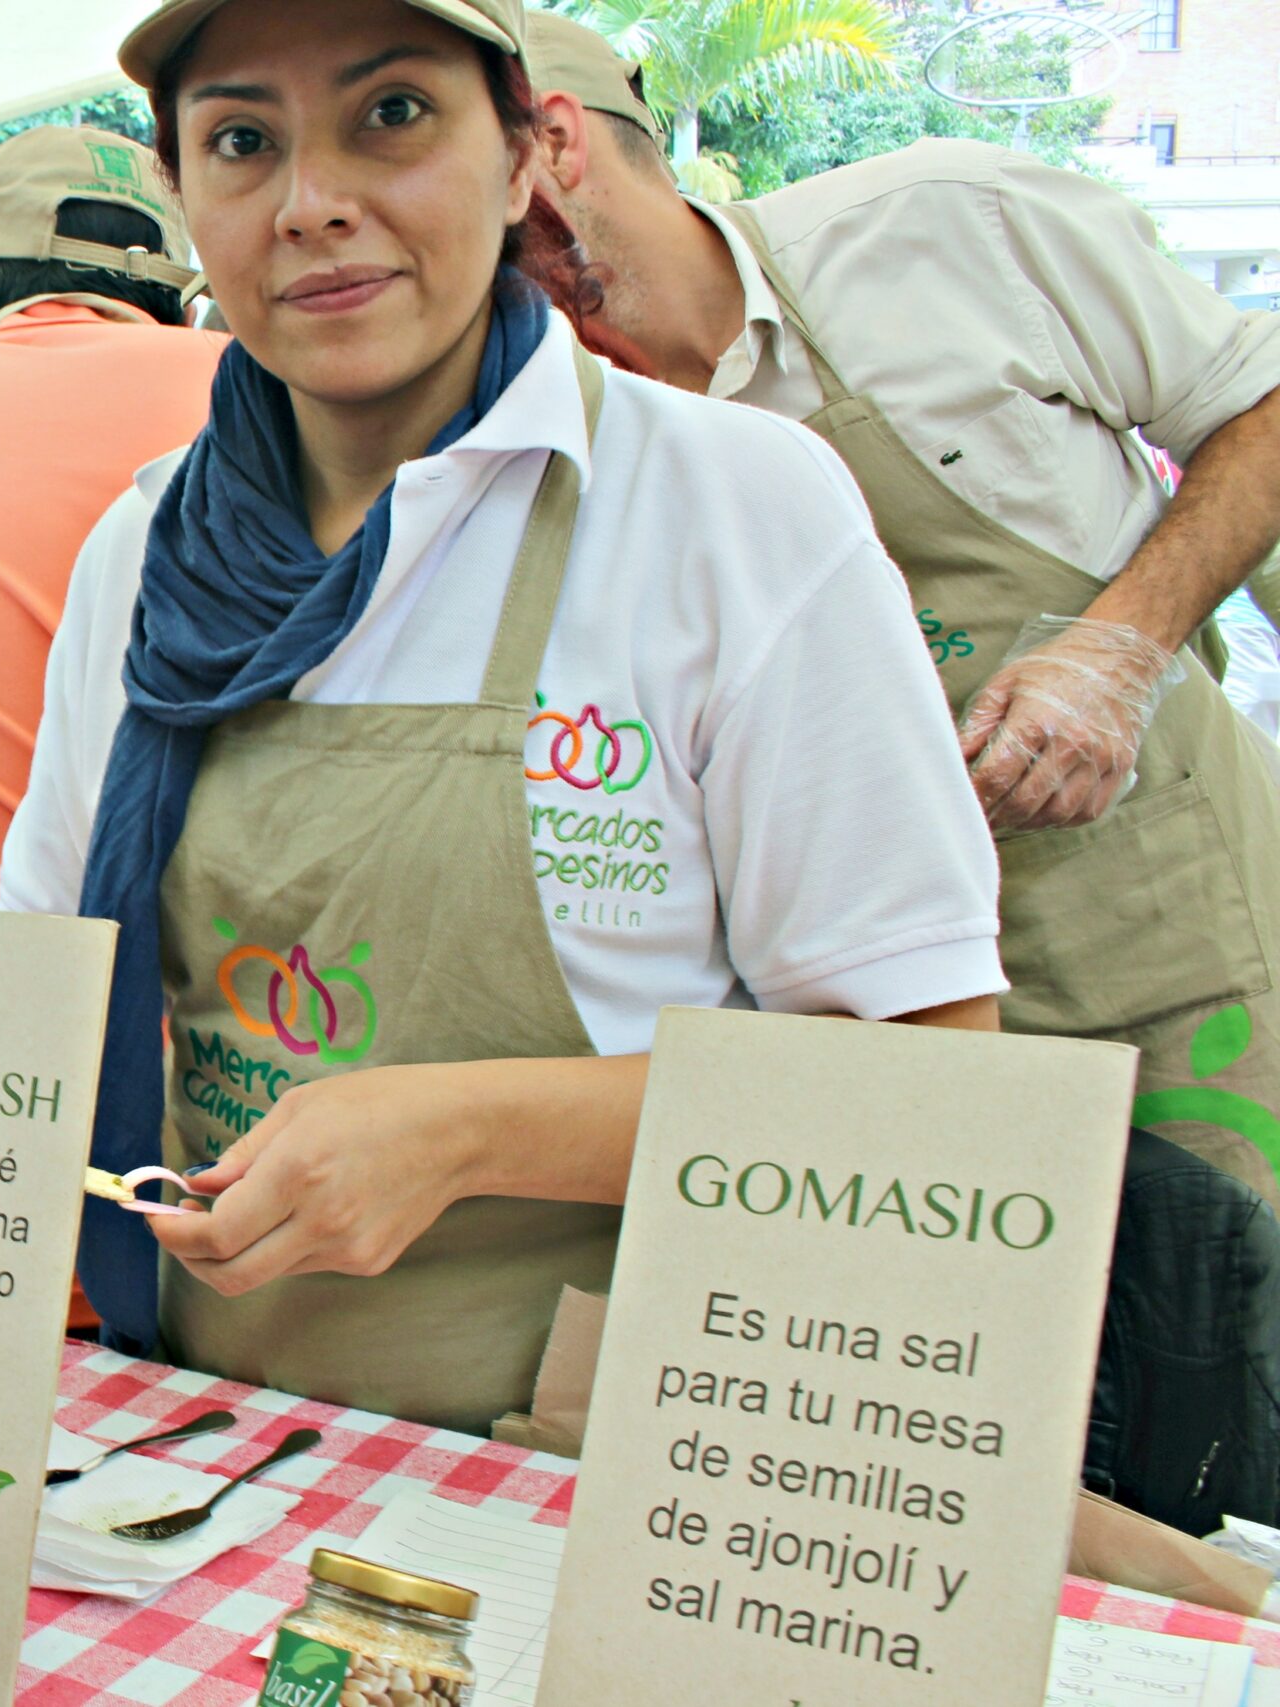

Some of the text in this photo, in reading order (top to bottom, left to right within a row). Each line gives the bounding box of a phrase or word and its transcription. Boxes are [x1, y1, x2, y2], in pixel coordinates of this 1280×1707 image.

[530, 804, 664, 853] rcados
[677, 1154, 1055, 1250] GOMASIO
[702, 1291, 980, 1377] Es una sal
[656, 1364, 1005, 1458] para tu mesa
[669, 1430, 966, 1525] de semillas
[648, 1497, 969, 1612] de ajonjolí y
[646, 1577, 934, 1674] sal marina.
[266, 1660, 338, 1707] basil
